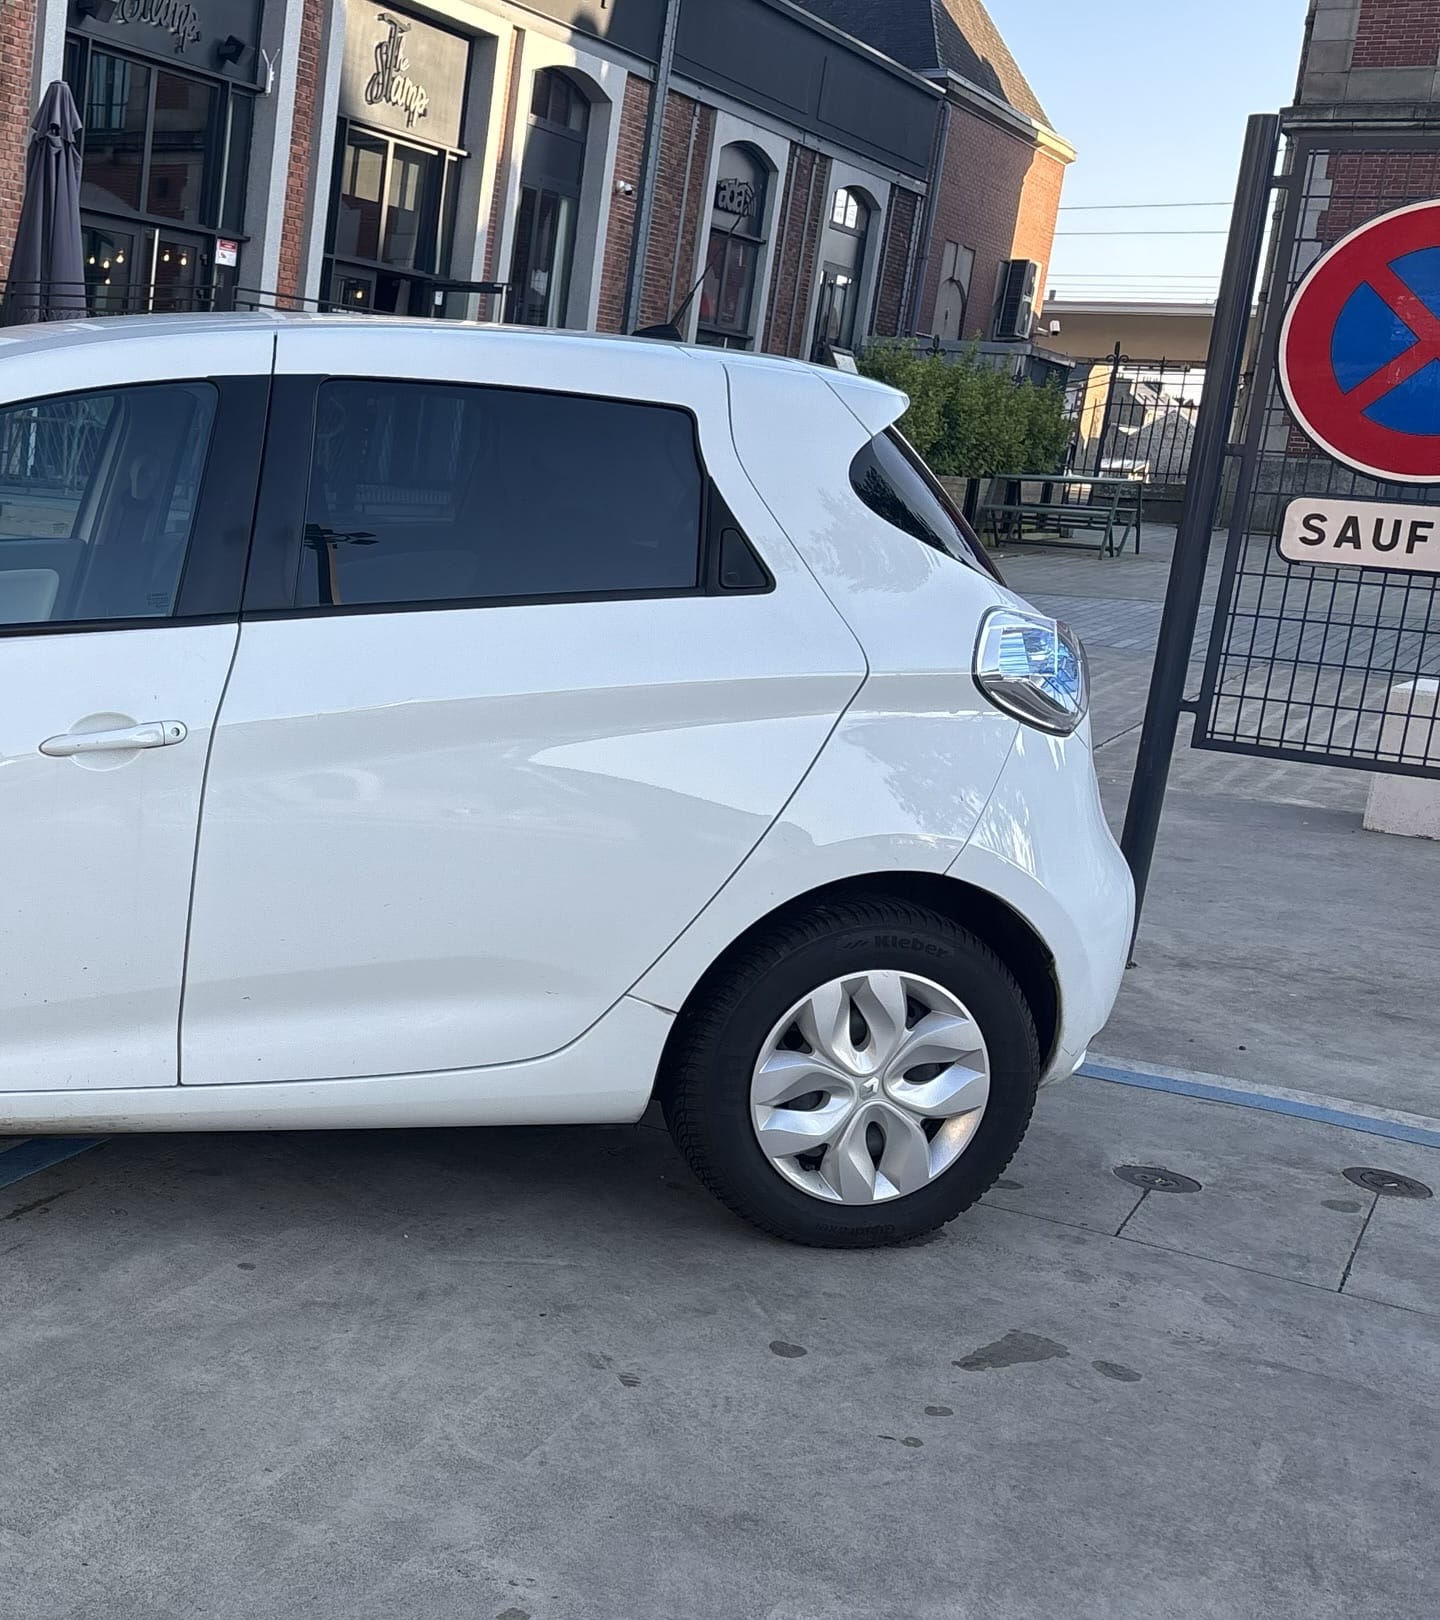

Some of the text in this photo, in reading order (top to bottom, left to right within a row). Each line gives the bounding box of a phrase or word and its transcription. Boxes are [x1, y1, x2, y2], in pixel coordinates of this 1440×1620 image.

[377, 13, 411, 74] The
[365, 41, 428, 128] Stamp
[1298, 513, 1435, 554] SAUF
[874, 935, 948, 957] Kleber
